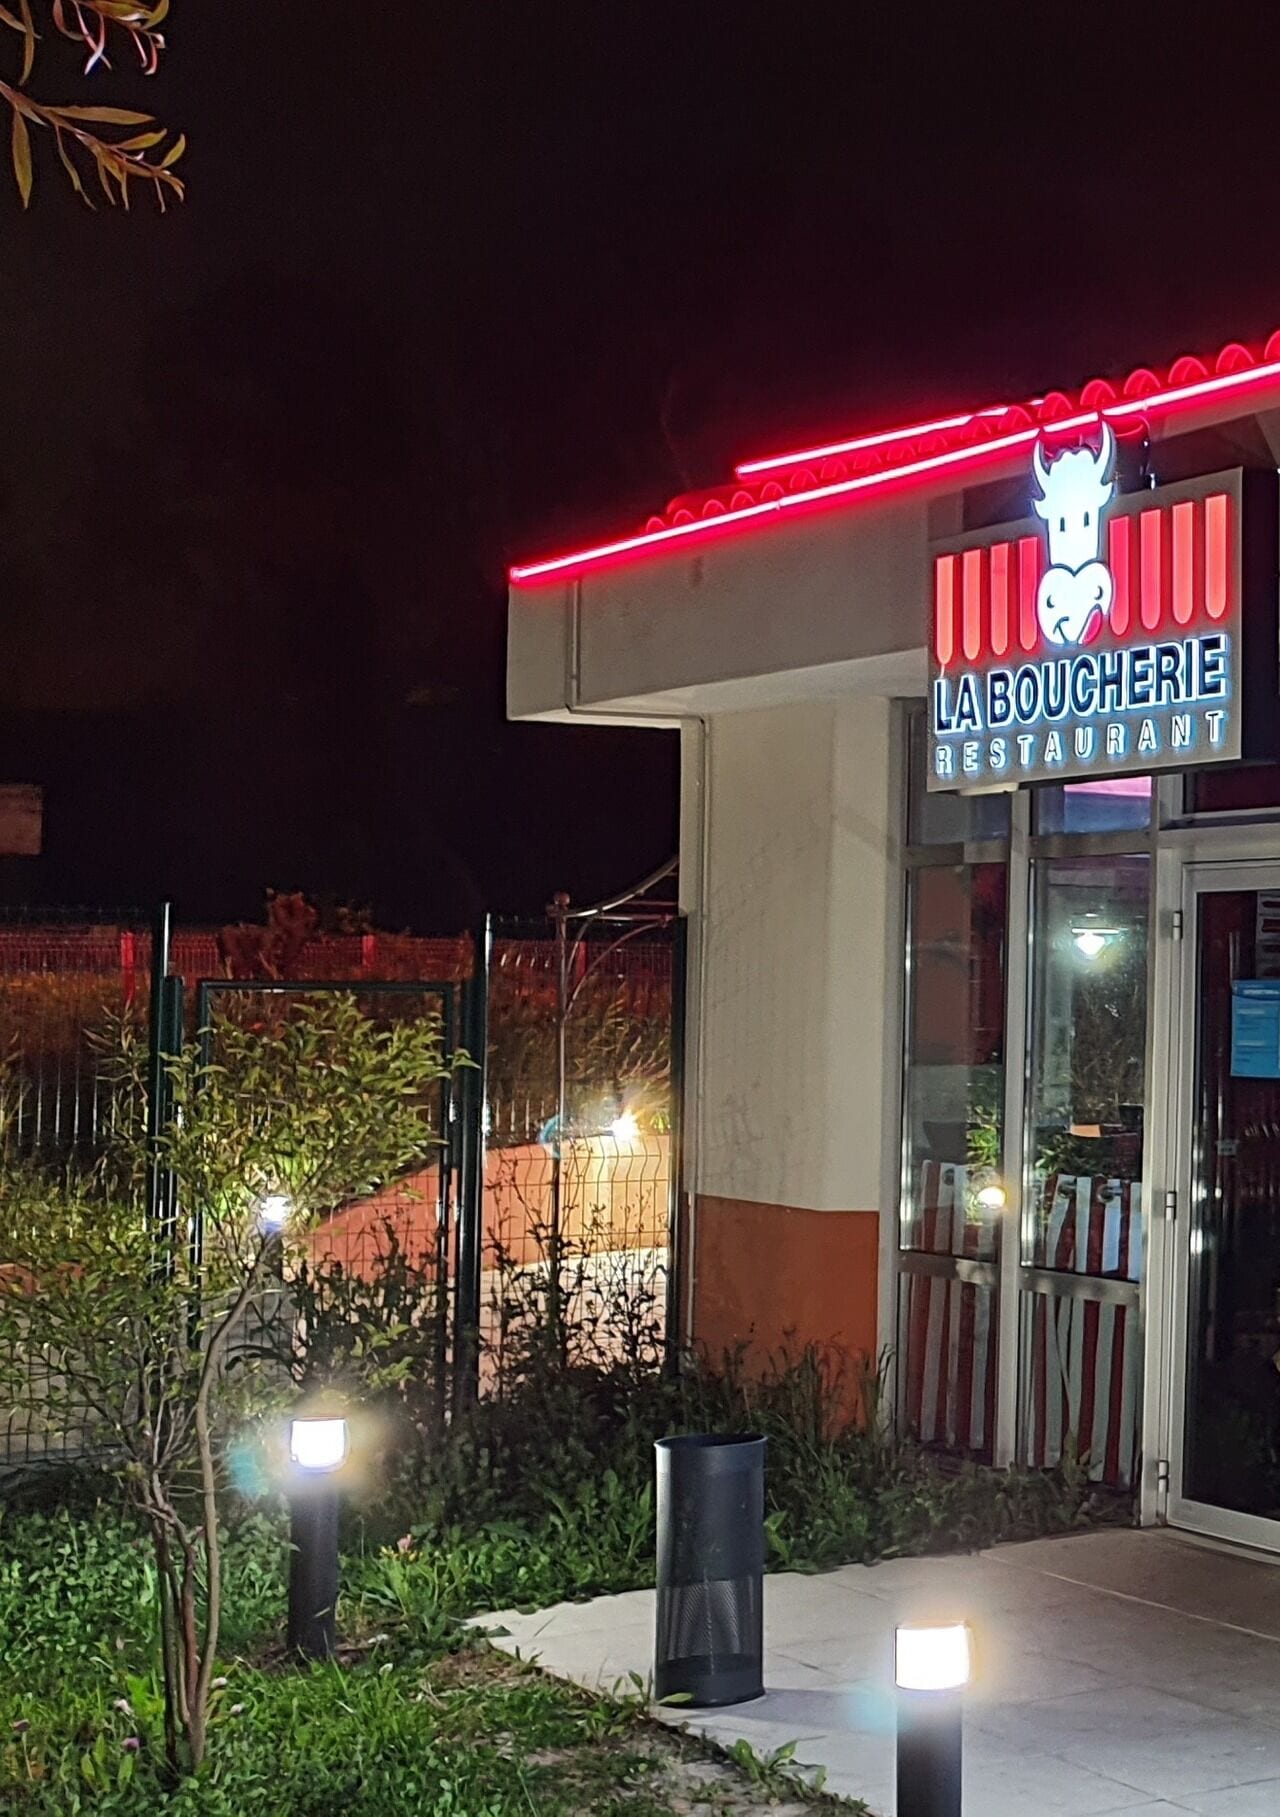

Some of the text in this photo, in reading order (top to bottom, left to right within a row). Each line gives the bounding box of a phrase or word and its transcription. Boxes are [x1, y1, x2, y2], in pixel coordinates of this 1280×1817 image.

[934, 635, 1228, 734] LA BOUCHERIE
[936, 710, 1224, 774] RESTAURANT
